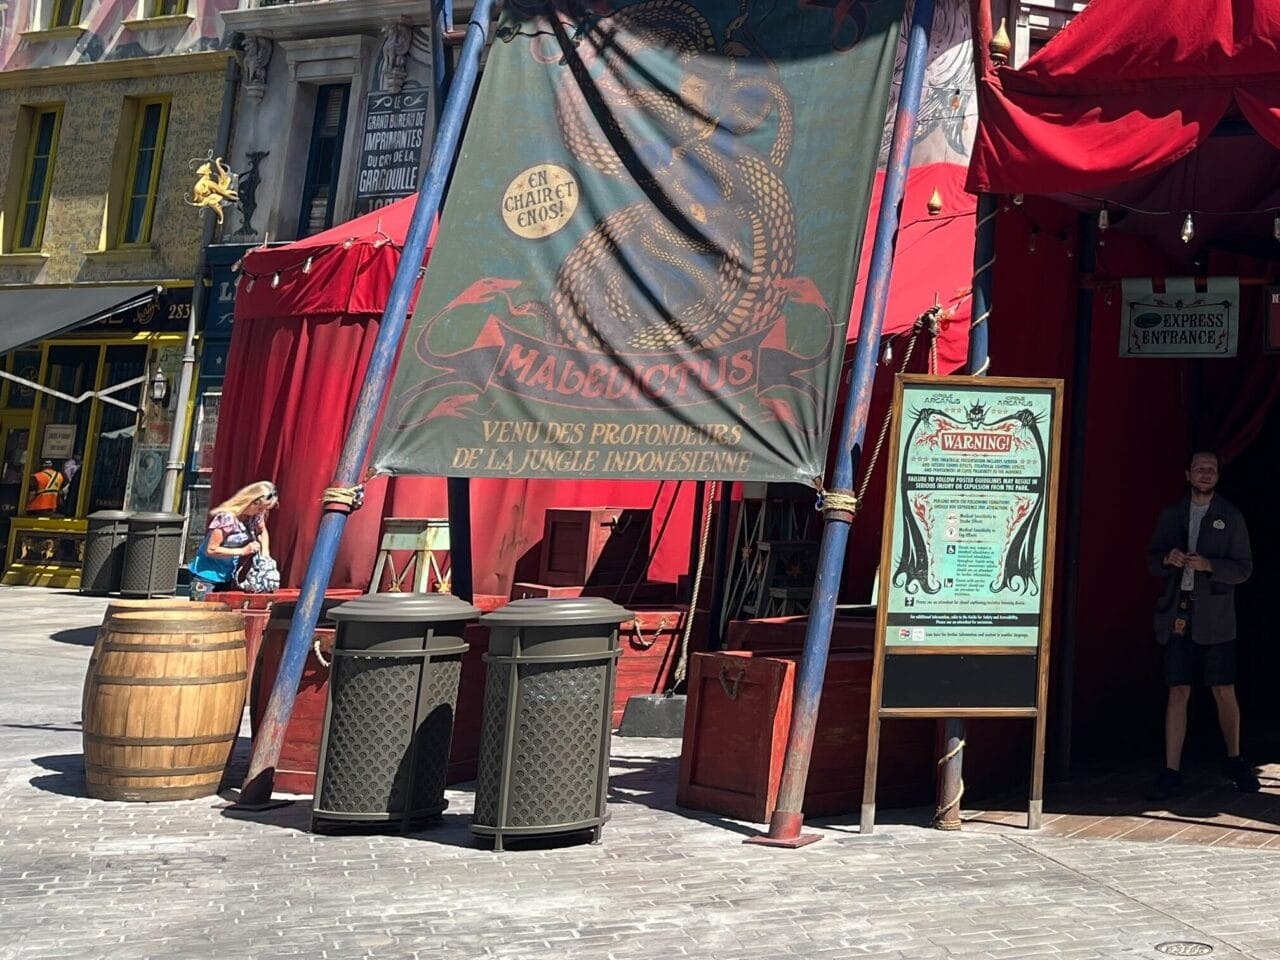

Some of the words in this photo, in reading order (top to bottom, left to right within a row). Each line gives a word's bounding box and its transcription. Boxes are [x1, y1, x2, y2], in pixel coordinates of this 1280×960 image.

[394, 95, 402, 109] LE
[367, 114, 389, 130] GRAND
[416, 112, 425, 127] DE
[364, 128, 423, 151] IMPRIMANTES
[367, 154, 377, 167] DU
[378, 153, 392, 167] CRI
[393, 150, 403, 163] DE
[359, 166, 419, 193] GARGOUILLE
[528, 170, 548, 189] EN
[504, 187, 554, 213] CHAIR
[555, 181, 574, 200] ET
[1163, 313, 1224, 328] EXPRESS
[1141, 330, 1216, 345] ENTRANCE
[499, 343, 753, 400] MALEDICTUS
[924, 397, 961, 405] ARCANUS
[481, 420, 543, 443] VENU
[545, 421, 585, 445] DES
[588, 422, 744, 446] PROFONDEURS
[944, 435, 1010, 450] WARNING!
[452, 447, 484, 470] DE
[487, 448, 515, 471] LA
[516, 449, 600, 474] JUNGLE
[602, 447, 753, 473] INDONÉSIENNE
